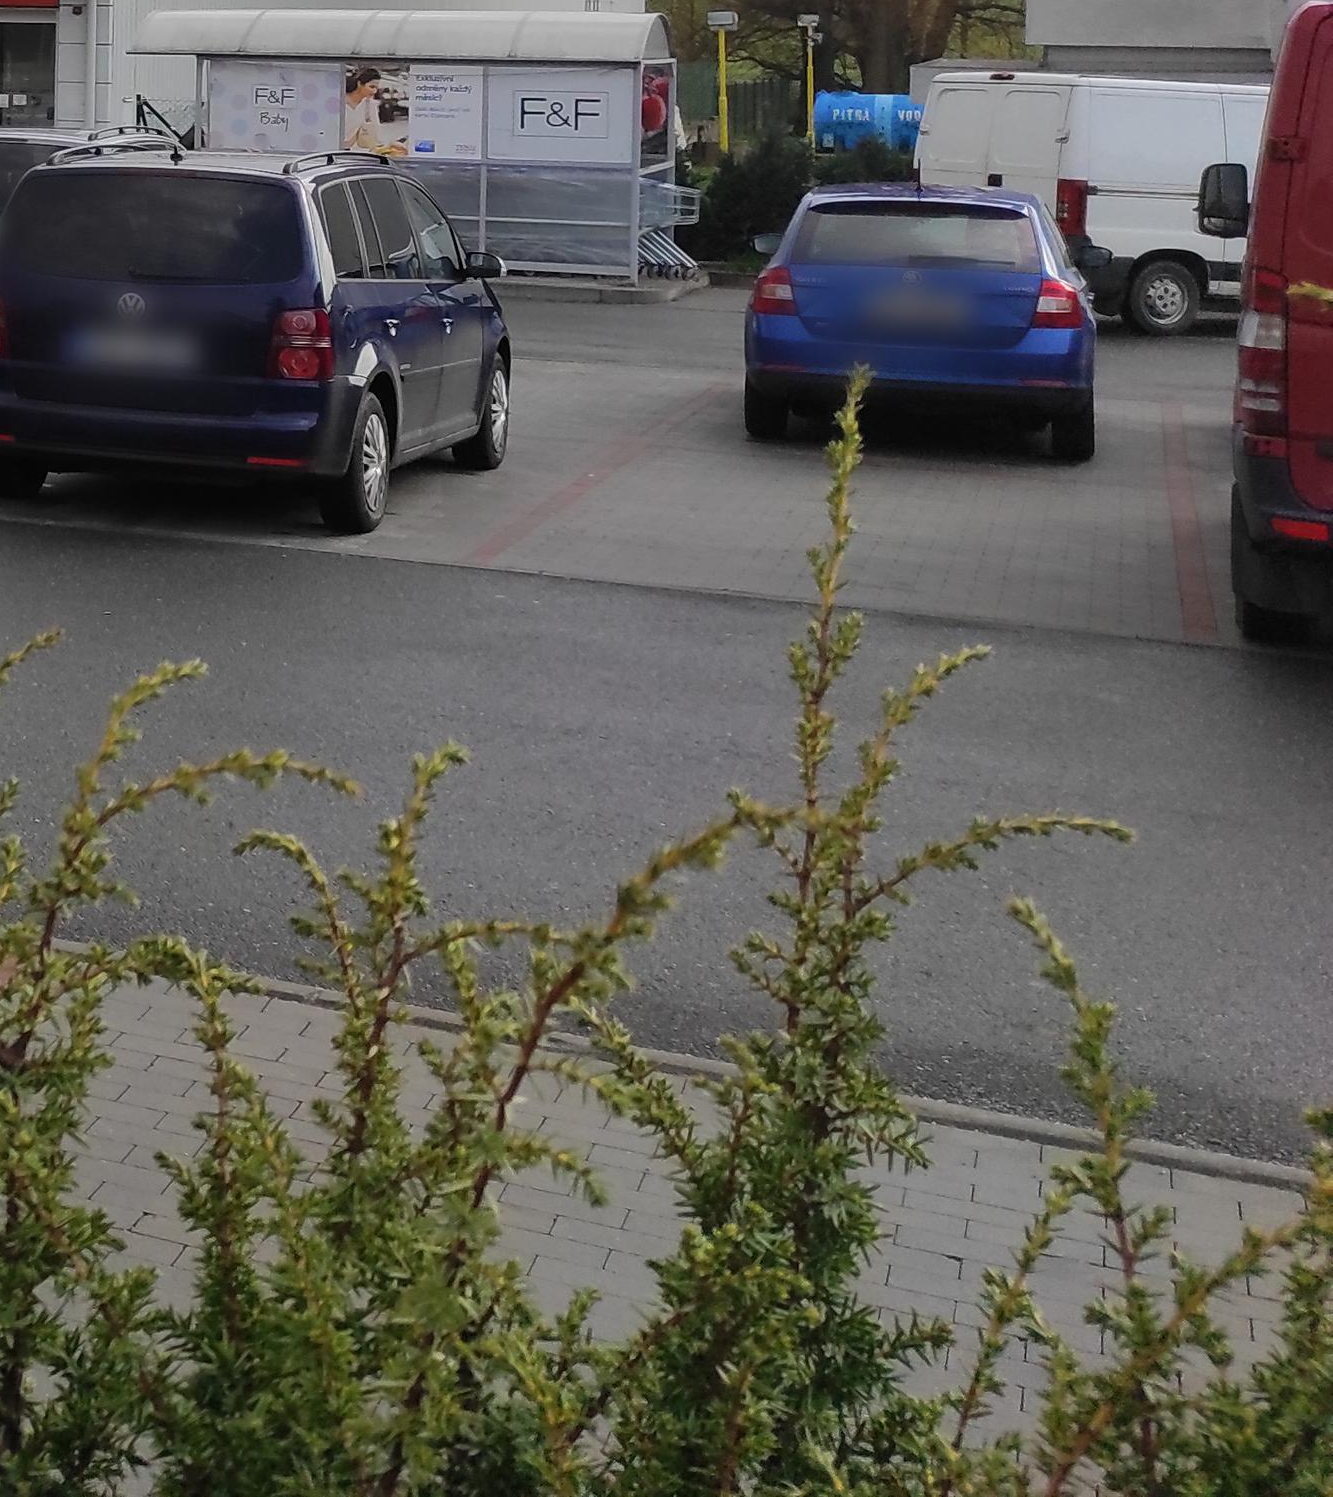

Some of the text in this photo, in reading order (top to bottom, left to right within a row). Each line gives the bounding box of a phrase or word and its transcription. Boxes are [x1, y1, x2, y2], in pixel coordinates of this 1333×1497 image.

[255, 88, 295, 105] F&F
[520, 97, 601, 131] F&F
[898, 110, 922, 122] VOD
